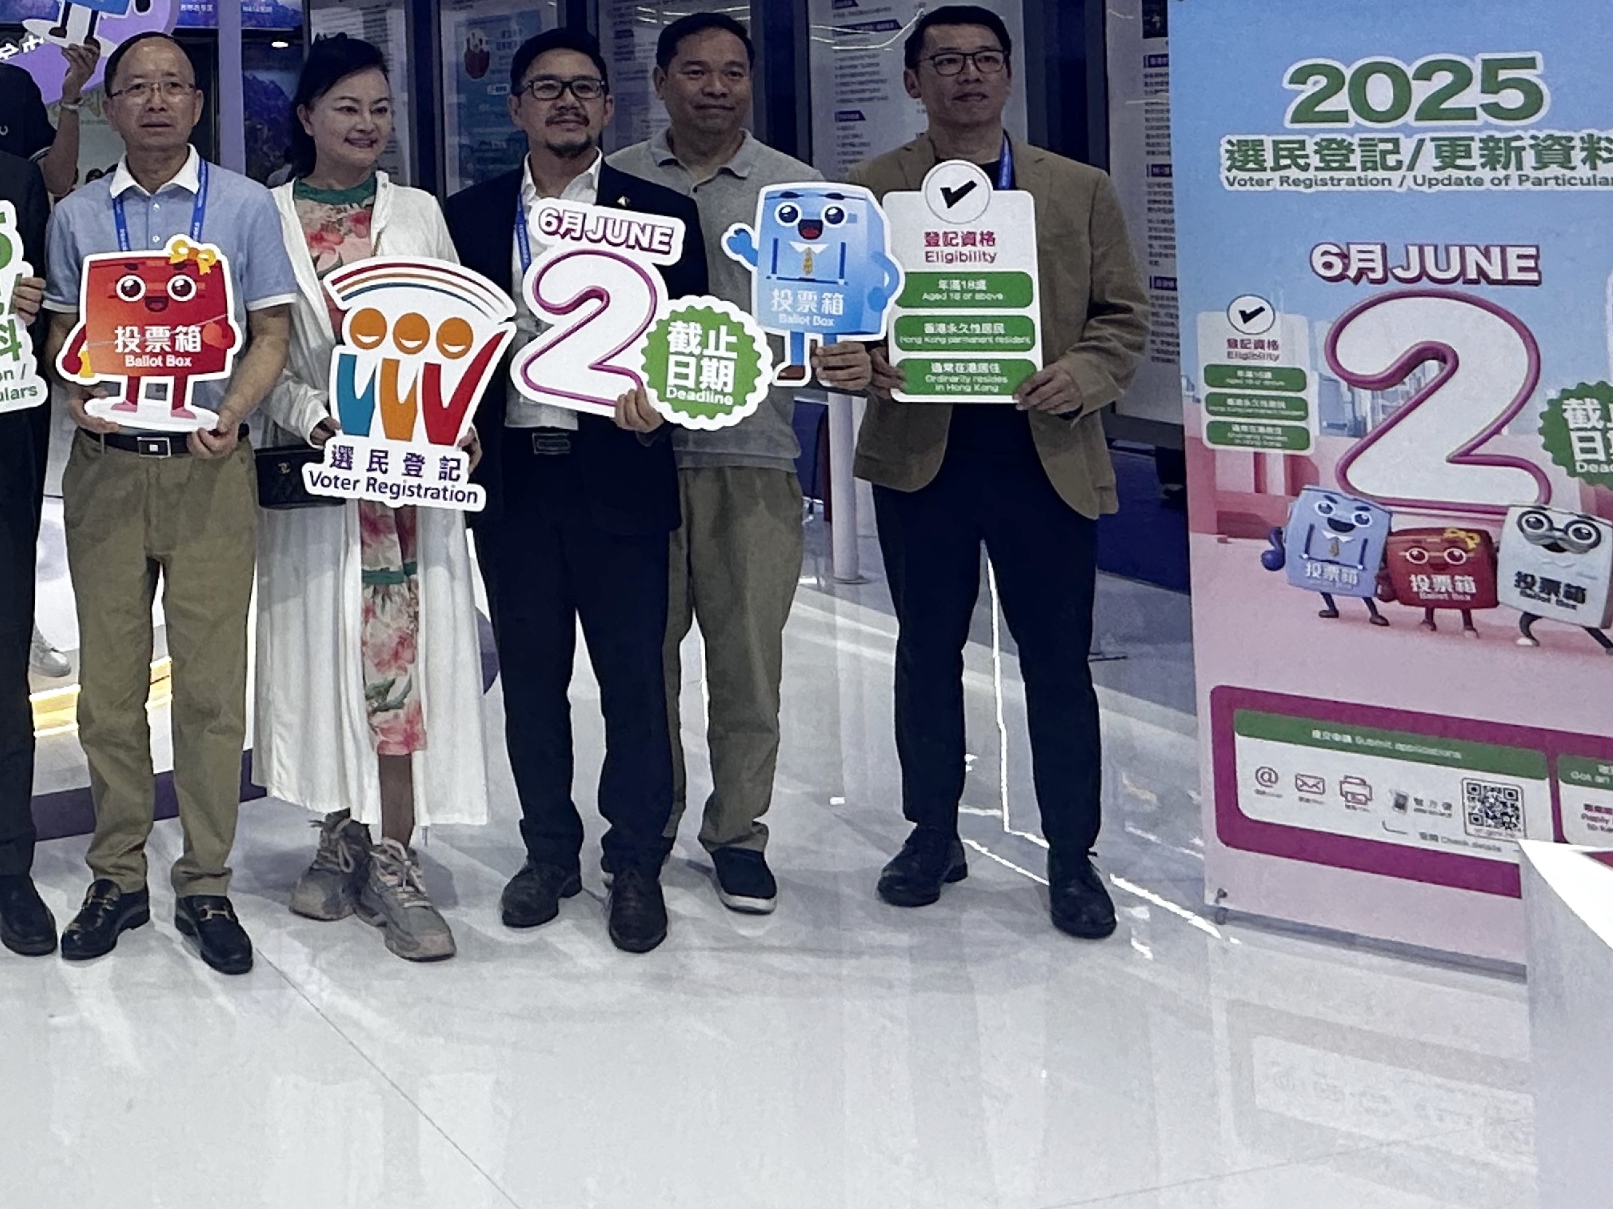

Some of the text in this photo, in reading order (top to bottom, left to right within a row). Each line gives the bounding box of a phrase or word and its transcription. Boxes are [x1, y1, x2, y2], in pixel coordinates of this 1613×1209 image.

[1285, 57, 1546, 124] 2025
[1226, 134, 1613, 173] 選民登記/更新資料
[1226, 174, 1273, 188] Voter
[1279, 173, 1392, 190] Registration
[1413, 174, 1484, 188] Update
[1490, 174, 1511, 187] of
[586, 216, 674, 255] JUNE
[924, 231, 996, 247] 登記資格
[925, 251, 997, 264] Eligibility
[1392, 243, 1542, 287] JUNE
[771, 289, 844, 316] 投票箱
[922, 292, 947, 302] Aged
[521, 248, 658, 407] 2
[779, 313, 835, 327] Ballot Box
[114, 325, 201, 353] 投票箱
[667, 321, 738, 360] 截止
[947, 337, 994, 345] permanent
[125, 355, 192, 368] Ballot Box
[666, 354, 735, 393] 日期
[666, 384, 734, 406] Deadline
[947, 384, 971, 392] Hong
[974, 384, 999, 392] Kong
[1325, 289, 1551, 512] 2
[329, 444, 462, 482] 選民登記
[308, 471, 477, 504] Voter Registration
[1305, 562, 1359, 586] 投票箱
[1409, 574, 1476, 595] 投票箱
[1515, 571, 1587, 605] 投票箱
